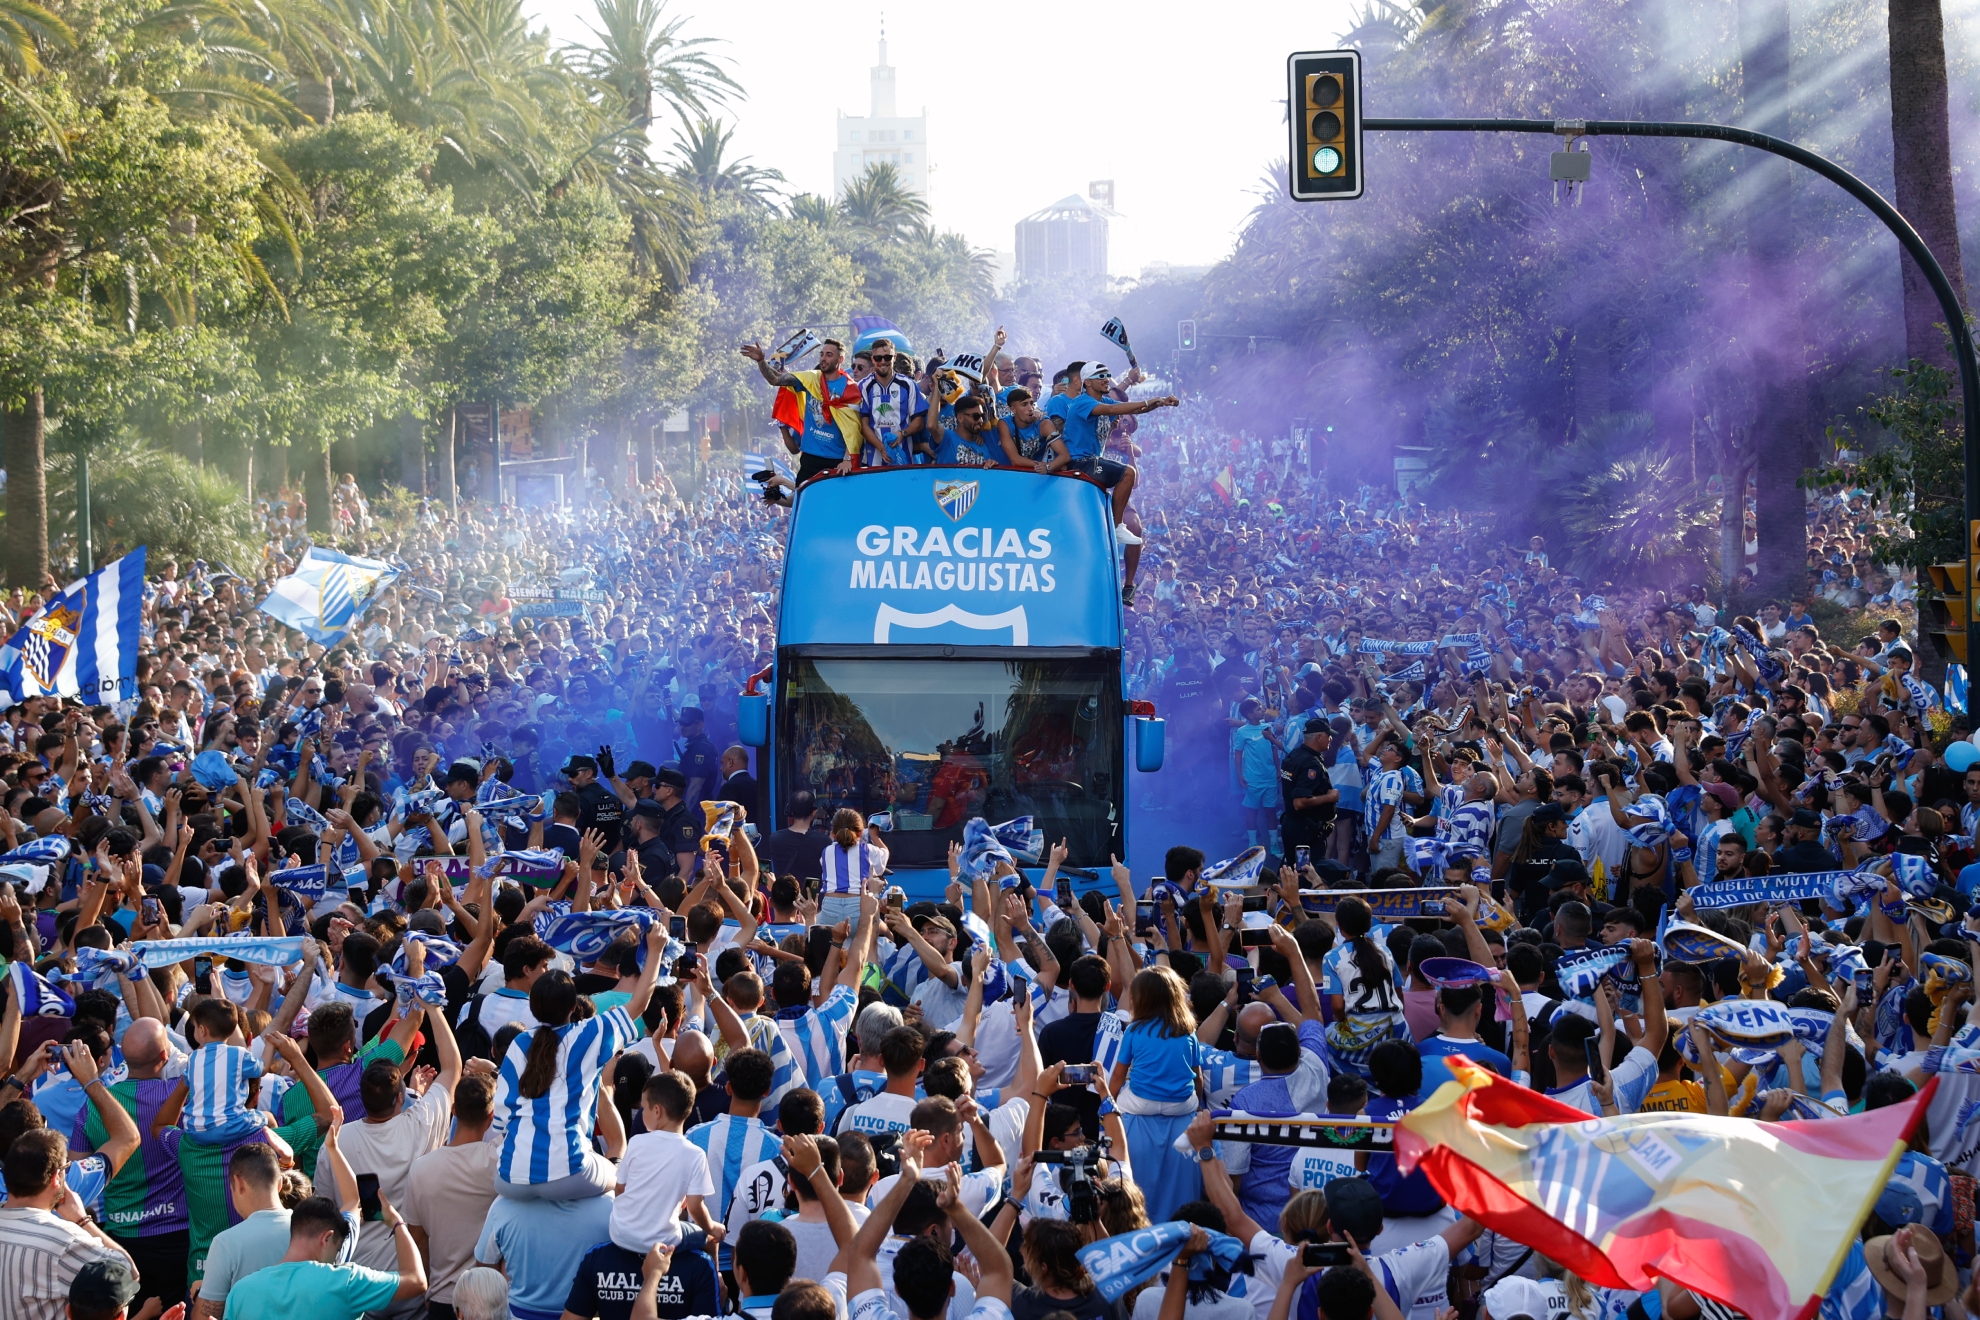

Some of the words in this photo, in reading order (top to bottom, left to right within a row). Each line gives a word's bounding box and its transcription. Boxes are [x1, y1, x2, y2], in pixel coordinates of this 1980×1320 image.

[856, 524, 1052, 559] GRACIAS
[850, 560, 1056, 592] MALAGUISTAS
[508, 587, 554, 599] SIEMPRE
[1452, 633, 1478, 644] MALAG
[1405, 641, 1429, 653] SUR
[1110, 822, 1119, 837] 7
[1703, 879, 1754, 894] NOBLE
[1761, 878, 1770, 889] Y
[1776, 874, 1811, 888] MUY
[1618, 981, 1639, 992] 1904
[854, 1115, 885, 1130] VIVO
[1304, 1157, 1334, 1172] VIVO
[109, 1202, 175, 1223] BENAHAVIS
[597, 1272, 684, 1292] MALGA
[598, 1290, 624, 1301] CLUB
[657, 1293, 684, 1304] TBOL
